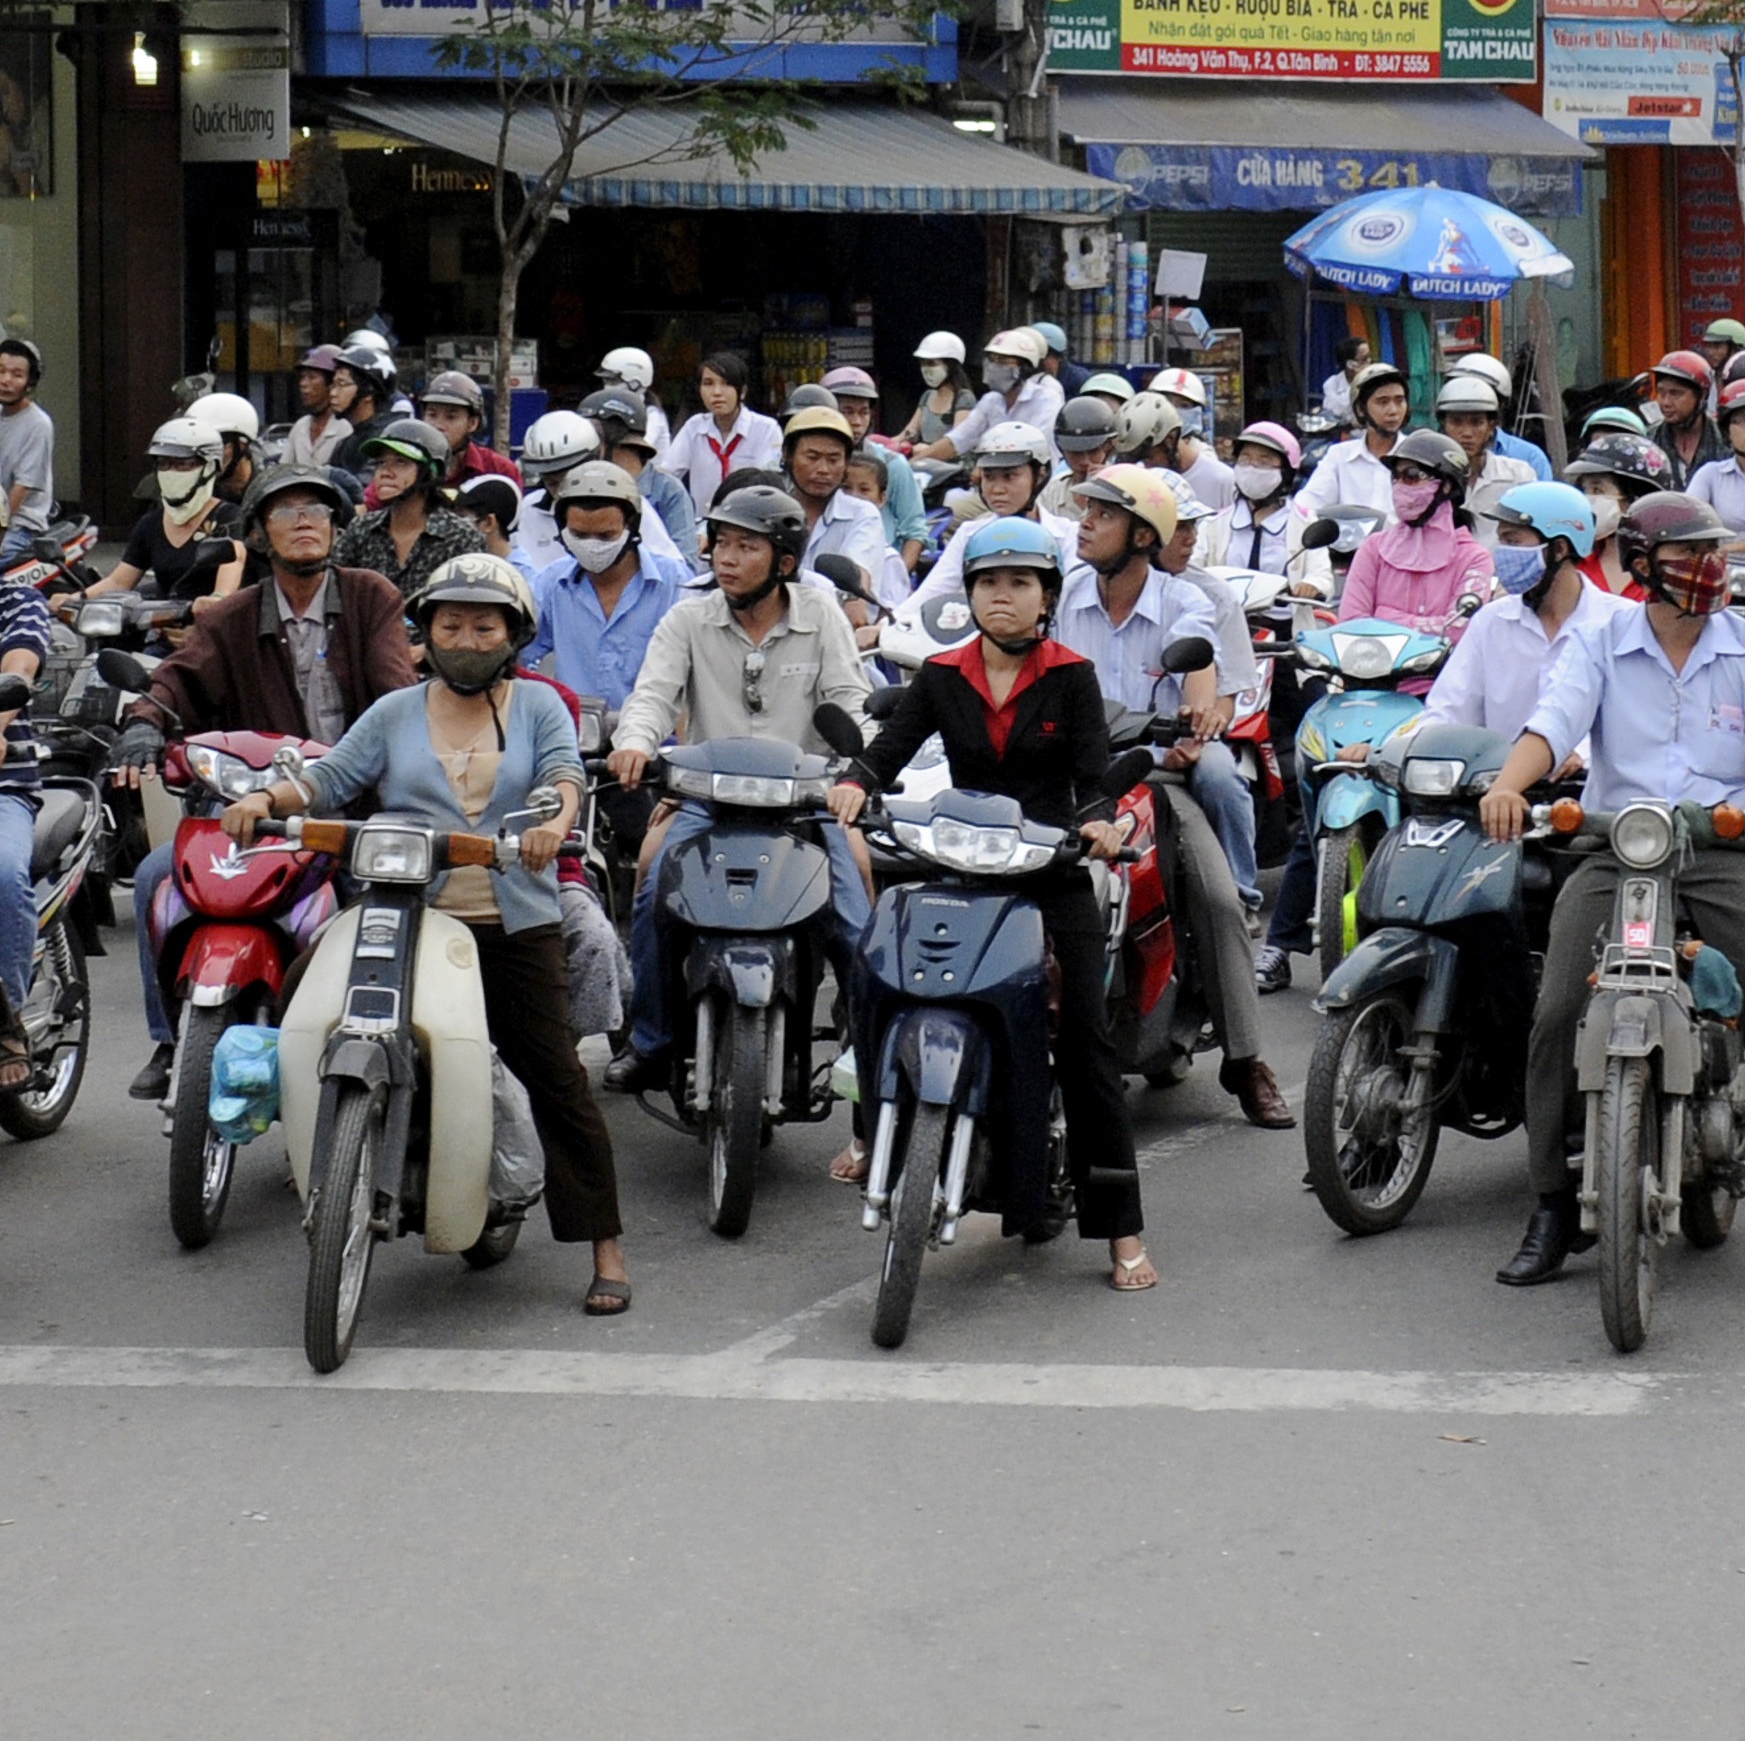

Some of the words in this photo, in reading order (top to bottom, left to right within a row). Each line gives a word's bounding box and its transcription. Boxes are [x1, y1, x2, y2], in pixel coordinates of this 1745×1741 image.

[1149, 21, 1186, 38] Nhận
[1189, 22, 1212, 39] đặt
[1215, 23, 1236, 42] gói
[1240, 24, 1265, 43] quà
[1270, 23, 1290, 40] Tết
[1301, 26, 1332, 41] Giao
[1334, 26, 1368, 46] hàng
[1371, 28, 1393, 44] tận
[1395, 28, 1415, 43] nơi
[1133, 47, 1154, 66] 341
[1157, 48, 1198, 72] Hoàng
[1201, 50, 1226, 68] Văn
[1374, 55, 1401, 74] 3847
[1403, 56, 1430, 74] 5556
[1635, 101, 1683, 114] Jetstar
[1152, 164, 1208, 184] PEPSI
[1336, 159, 1419, 191] 341
[1358, 272, 1392, 288] LADY
[1413, 280, 1461, 293] DUTCH
[1464, 282, 1500, 296] LADY
[921, 897, 970, 907] HONDA
